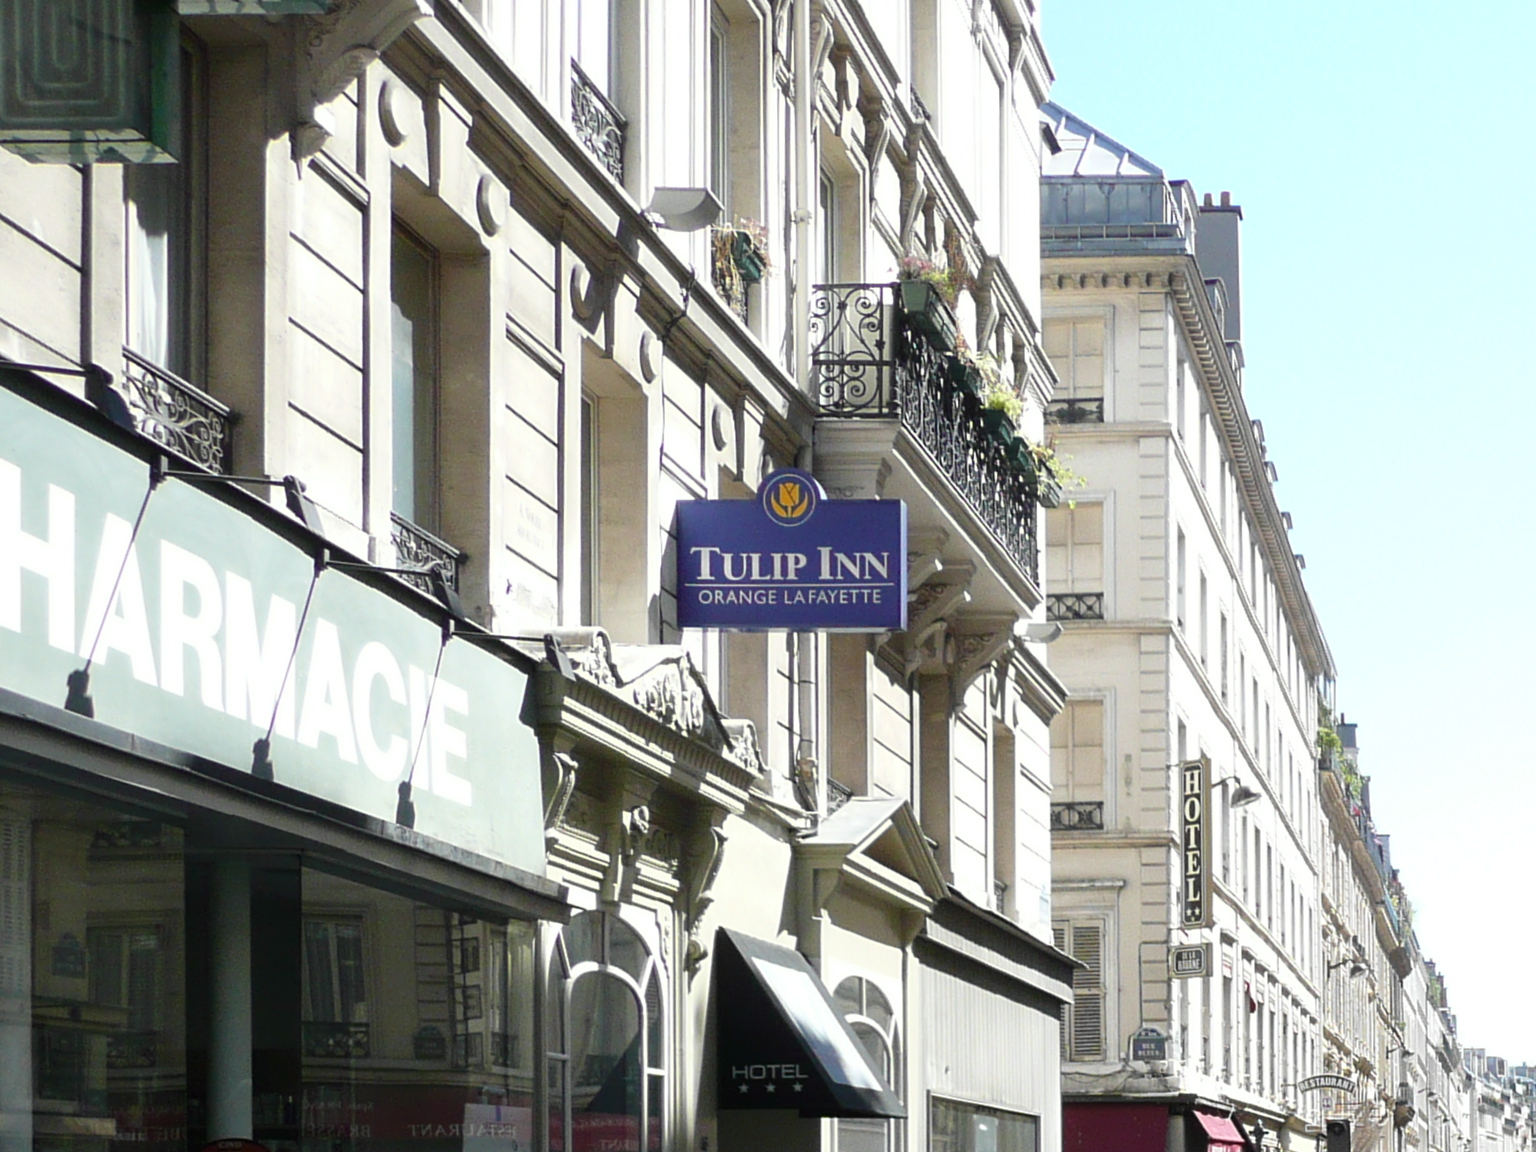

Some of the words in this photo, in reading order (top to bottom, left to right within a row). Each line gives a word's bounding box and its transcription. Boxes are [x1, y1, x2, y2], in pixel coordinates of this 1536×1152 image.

[690, 547, 807, 581] TULIP
[817, 546, 890, 580] INN
[698, 589, 777, 604] ORANGE
[784, 588, 881, 604] LAFAYETTE
[1184, 770, 1201, 902] HOTEL
[732, 1064, 809, 1080] HOTEL
[1299, 1076, 1354, 1093] RESTAURANT
